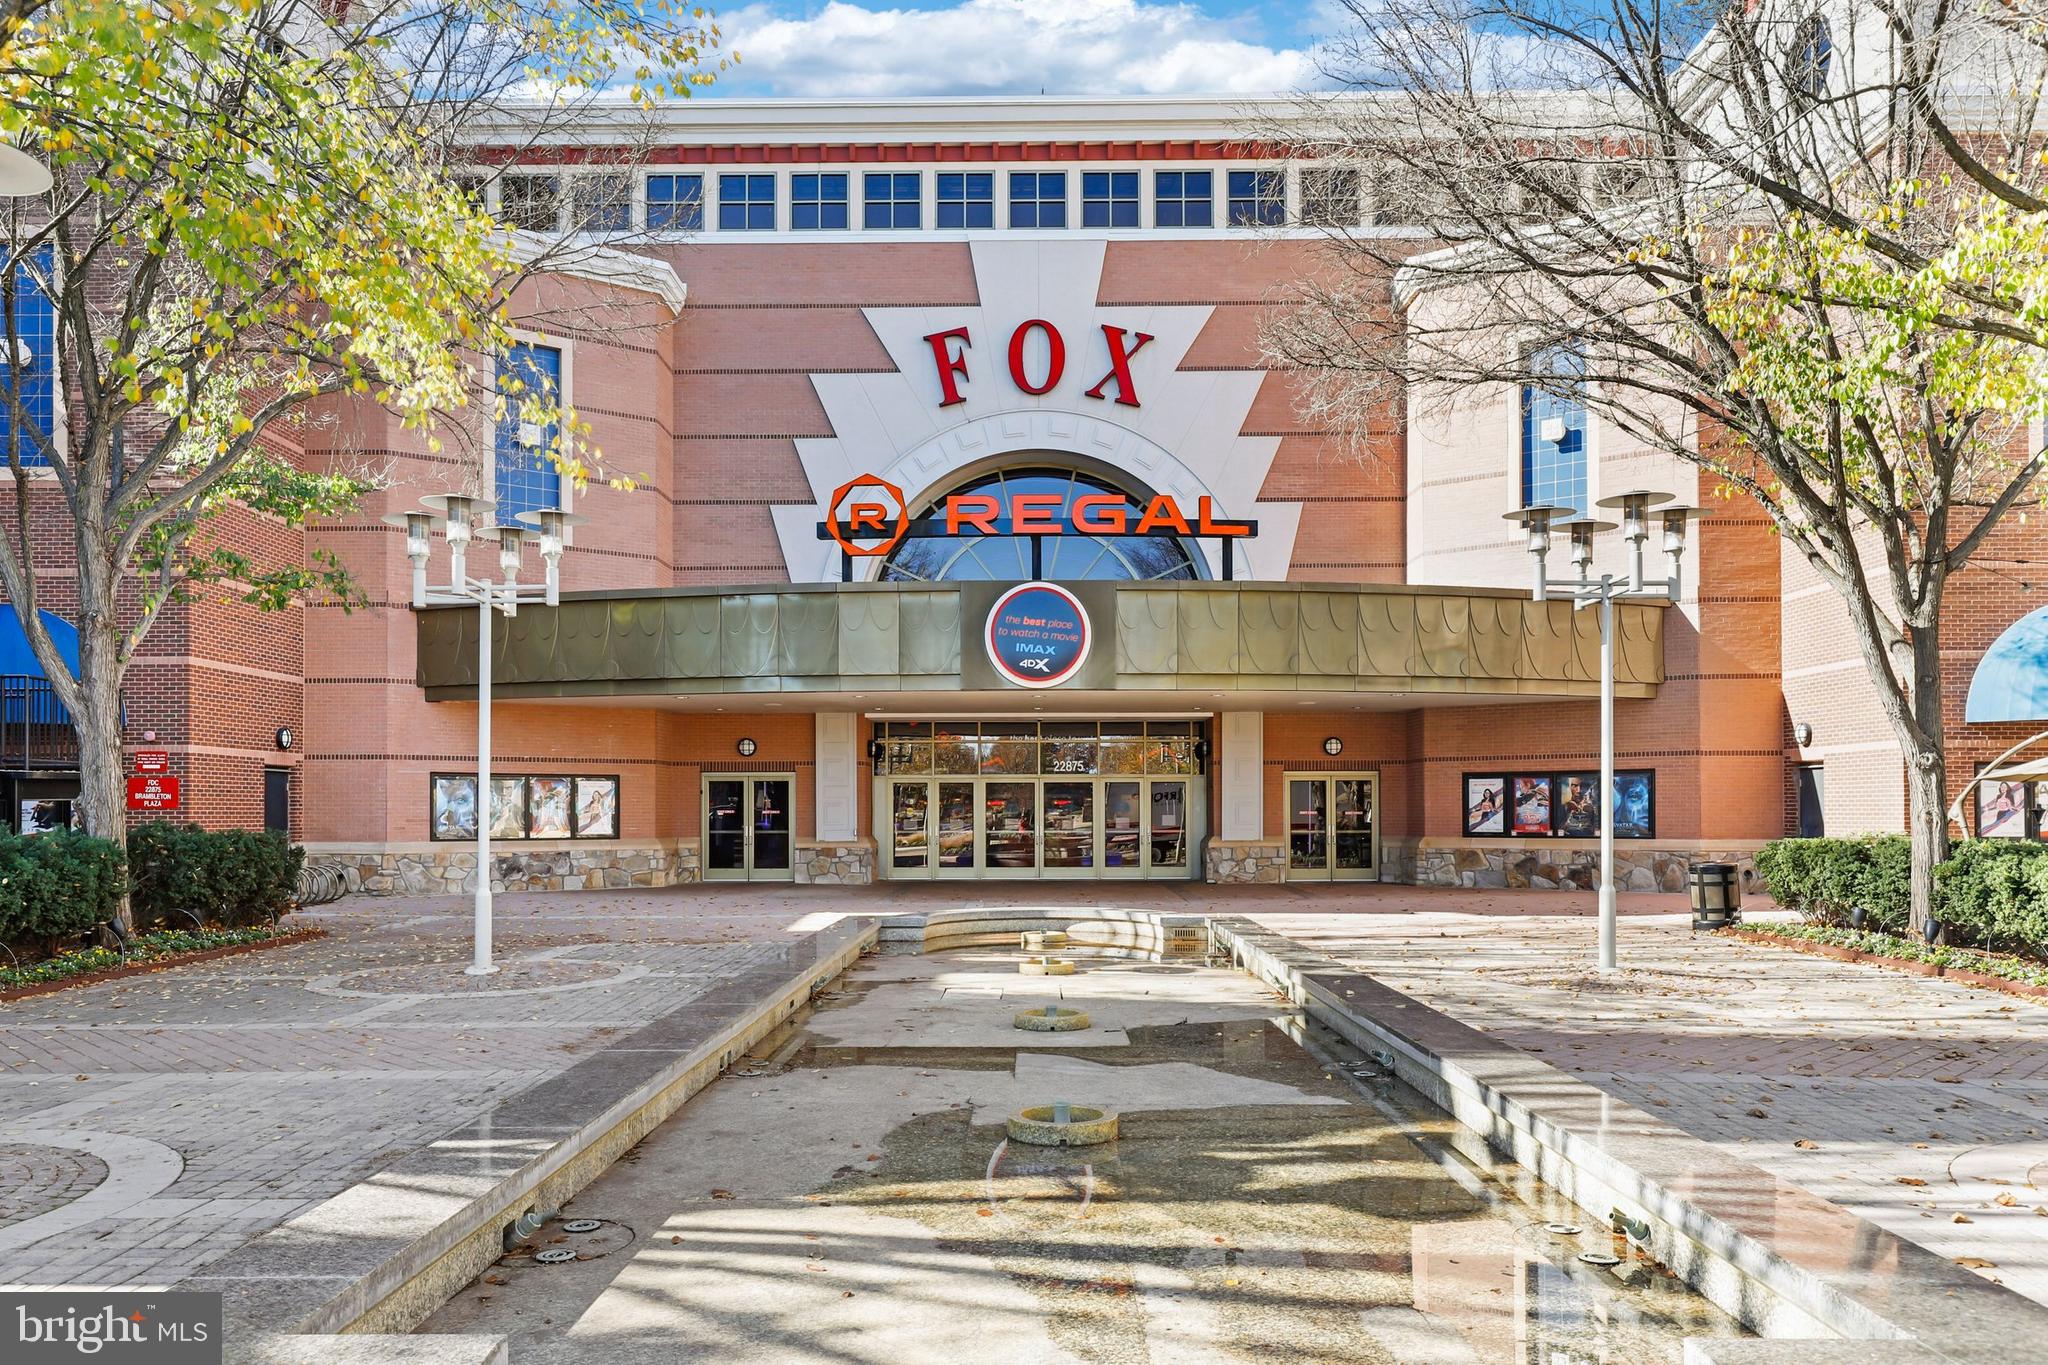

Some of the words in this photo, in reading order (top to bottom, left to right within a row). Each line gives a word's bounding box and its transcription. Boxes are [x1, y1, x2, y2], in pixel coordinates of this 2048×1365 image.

[923, 319, 1154, 408] FOX
[946, 495, 1249, 534] REGAL
[1005, 615, 1021, 625] the
[1022, 616, 1046, 626] best
[1047, 619, 1074, 630] place
[998, 627, 1008, 636] to
[1010, 629, 1040, 638] watch
[1041, 631, 1049, 639] a
[1050, 633, 1079, 642] movie
[1015, 643, 1056, 655] IMAX
[1019, 658, 1051, 673] 4DX
[1053, 760, 1085, 772] 22875
